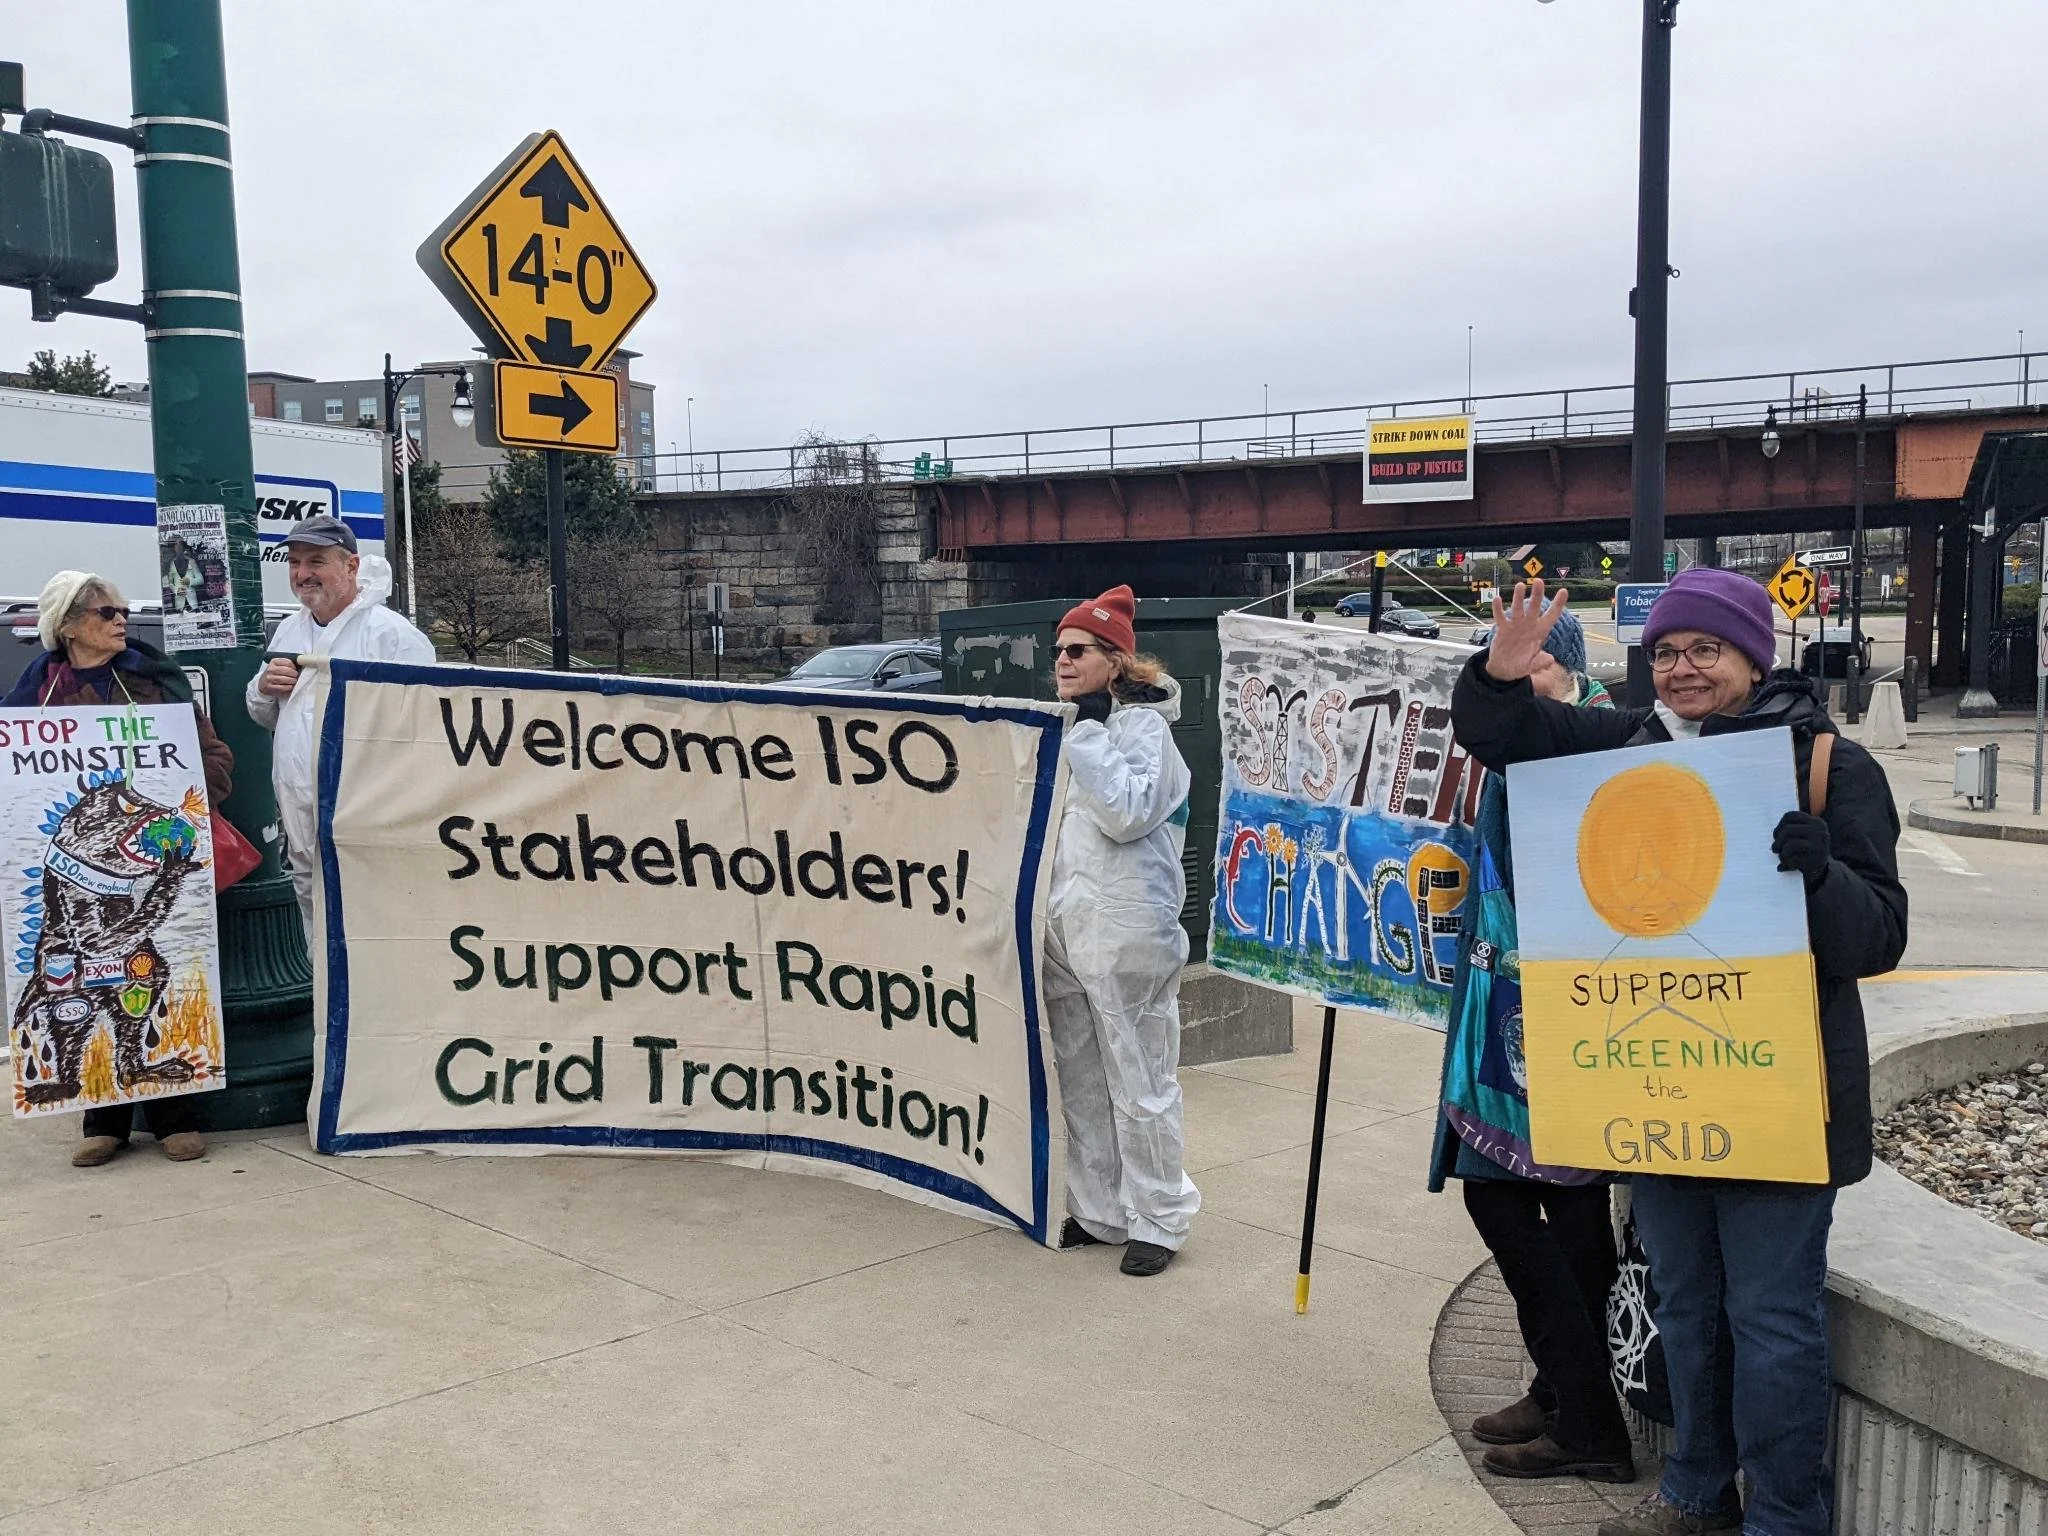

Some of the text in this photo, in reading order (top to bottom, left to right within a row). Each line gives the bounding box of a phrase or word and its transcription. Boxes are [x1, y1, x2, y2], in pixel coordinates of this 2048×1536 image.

[1372, 428, 1466, 443] STRIKE DOWN COAL
[1371, 460, 1464, 477] BUILD UP JUSTICE
[200, 509, 220, 522] LIVE
[256, 497, 327, 521] SKE
[260, 546, 288, 563] Ren
[1828, 552, 1845, 560] WAY
[1624, 596, 1656, 606] Tobac
[0, 716, 159, 748] STOP THE
[439, 697, 959, 793] Welcome ISO
[12, 743, 188, 775] MONSTER
[49, 851, 131, 894] ISO new england
[438, 813, 970, 924] Stakeholders!
[1223, 813, 1462, 985] CHANGE
[85, 963, 122, 979] EXXON
[449, 925, 979, 1044] Support Rapid
[1570, 971, 1751, 1006] SUPPORT
[58, 1005, 85, 1018] ESSO
[1573, 1039, 1775, 1069] GREENING
[435, 1036, 990, 1165] Grid Transition!
[1643, 1075, 1687, 1100] the
[1603, 1117, 1732, 1164] GRID
